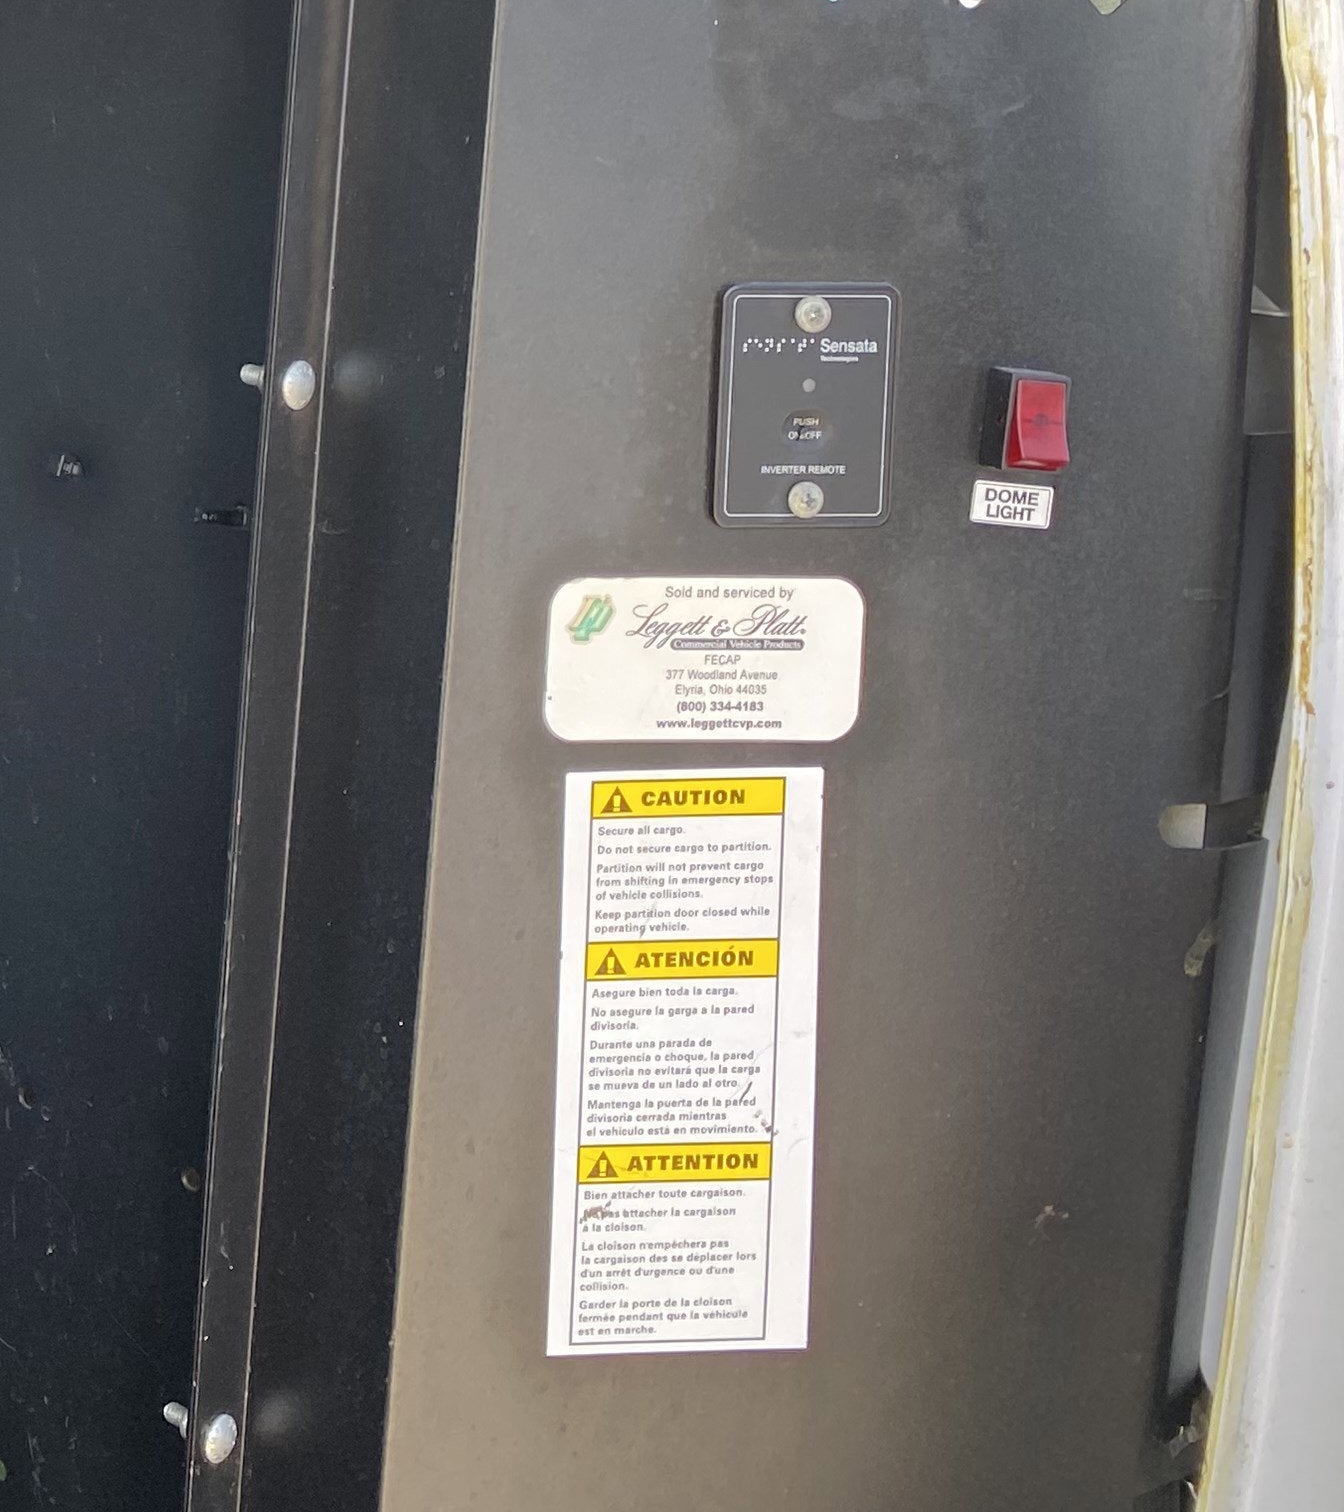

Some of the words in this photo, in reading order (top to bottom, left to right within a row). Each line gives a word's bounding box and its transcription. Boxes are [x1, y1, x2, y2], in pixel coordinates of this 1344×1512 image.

[820, 338, 877, 353] Sensata
[793, 418, 819, 426] PUSH
[761, 465, 806, 474] INVERTER
[808, 465, 845, 474] REMOTE
[985, 488, 1041, 506] DOME
[986, 502, 1037, 521] LIGHT
[665, 586, 692, 598] Sold
[697, 586, 719, 598] and
[724, 586, 775, 598] serviced
[779, 586, 794, 601] by
[626, 603, 713, 649] Leggett
[711, 619, 730, 638] &
[674, 640, 727, 649] Commercial
[729, 640, 761, 649] Vehicle
[764, 640, 801, 649] Products
[705, 655, 741, 665] FECAP
[666, 669, 684, 680] 377
[687, 669, 737, 680] Woodland
[740, 669, 778, 680] Avenue
[675, 684, 705, 697] Elyria,
[709, 684, 733, 694] Ohio
[736, 684, 767, 695] 44035
[677, 701, 706, 713] (800)
[710, 701, 763, 711] 334-4183
[656, 718, 782, 730] www.leggettcvp.com
[641, 789, 745, 806] CAUTION
[598, 826, 634, 836] Secure
[638, 825, 650, 835] all
[653, 827, 686, 836] cargo.
[598, 845, 612, 854] Do
[615, 845, 633, 854] not
[674, 845, 704, 854] cargo
[708, 843, 718, 852] to
[722, 841, 771, 853] partition.
[597, 863, 642, 873] Partition
[646, 863, 665, 872] will
[669, 863, 686, 871] not
[690, 862, 731, 873] prevent
[734, 863, 764, 872] cargo
[596, 877, 621, 886] from
[625, 876, 665, 887] shifting
[668, 875, 678, 884] in
[682, 877, 740, 886] emergency
[744, 875, 773, 885] stops
[596, 891, 606, 901] of
[609, 890, 647, 900] vehicle
[650, 889, 703, 899] collisions.
[595, 910, 621, 921] Keep
[674, 908, 699, 917] door
[702, 907, 737, 917] closed
[741, 906, 770, 916] while
[649, 922, 689, 931] vehicle.
[634, 945, 754, 968] ATENCIÓN
[592, 989, 636, 999] Asegure
[639, 988, 662, 996] bien
[665, 987, 689, 996] toda
[693, 986, 702, 995] la
[706, 988, 738, 997] carga.
[591, 1008, 606, 1017] No
[610, 1009, 652, 1018] asegure
[655, 1006, 664, 1015] la
[711, 1005, 720, 1014] la
[724, 1004, 754, 1016] pared
[591, 1021, 638, 1031] divisoria.
[590, 1040, 632, 1050] Durante
[659, 1038, 695, 1050] parada
[699, 1038, 712, 1047] de
[589, 1053, 651, 1064] emergencia
[665, 1052, 707, 1063] choque,
[711, 1051, 719, 1060] la
[723, 1050, 754, 1062] pared
[589, 1067, 634, 1077] divisoria
[655, 1066, 691, 1075] evitará
[695, 1067, 715, 1076] que
[718, 1064, 727, 1074] la
[731, 1066, 760, 1075] carga
[642, 1080, 655, 1089] de
[676, 1079, 699, 1088] lado
[702, 1078, 712, 1088] al
[588, 1100, 641, 1110] Mantenga
[645, 1099, 654, 1108] la
[657, 1099, 692, 1109] puerta
[696, 1098, 708, 1107] de
[712, 1097, 721, 1106] la
[587, 1113, 632, 1123] divisoria
[636, 1112, 675, 1122] cerrada
[679, 1111, 726, 1120] mientras
[587, 1127, 596, 1136] el
[690, 1124, 757, 1134] movimiento.
[627, 1153, 758, 1170] ATTENTION
[584, 1191, 607, 1200] Bien
[611, 1190, 655, 1199] attacher
[659, 1189, 687, 1198] toute
[690, 1188, 745, 1199] cargaison.
[671, 1207, 680, 1216] la
[684, 1207, 736, 1218] cargaison
[592, 1223, 601, 1232] la
[605, 1222, 646, 1232] cloison.
[582, 1242, 594, 1251] La
[597, 1241, 636, 1251] cloison
[710, 1241, 729, 1250] pas
[581, 1256, 590, 1265] la
[594, 1255, 645, 1265] cargaison
[649, 1254, 667, 1263] des
[736, 1251, 756, 1260] lors
[580, 1281, 628, 1291] collision.
[579, 1300, 616, 1309] Garder
[619, 1299, 628, 1308] la
[632, 1300, 660, 1310] porte
[664, 1298, 677, 1307] de
[681, 1298, 690, 1307] la
[693, 1297, 732, 1306] cloison
[619, 1312, 663, 1323] pendant
[667, 1313, 686, 1322] que
[578, 1328, 595, 1336] est
[614, 1325, 656, 1334] marche.
